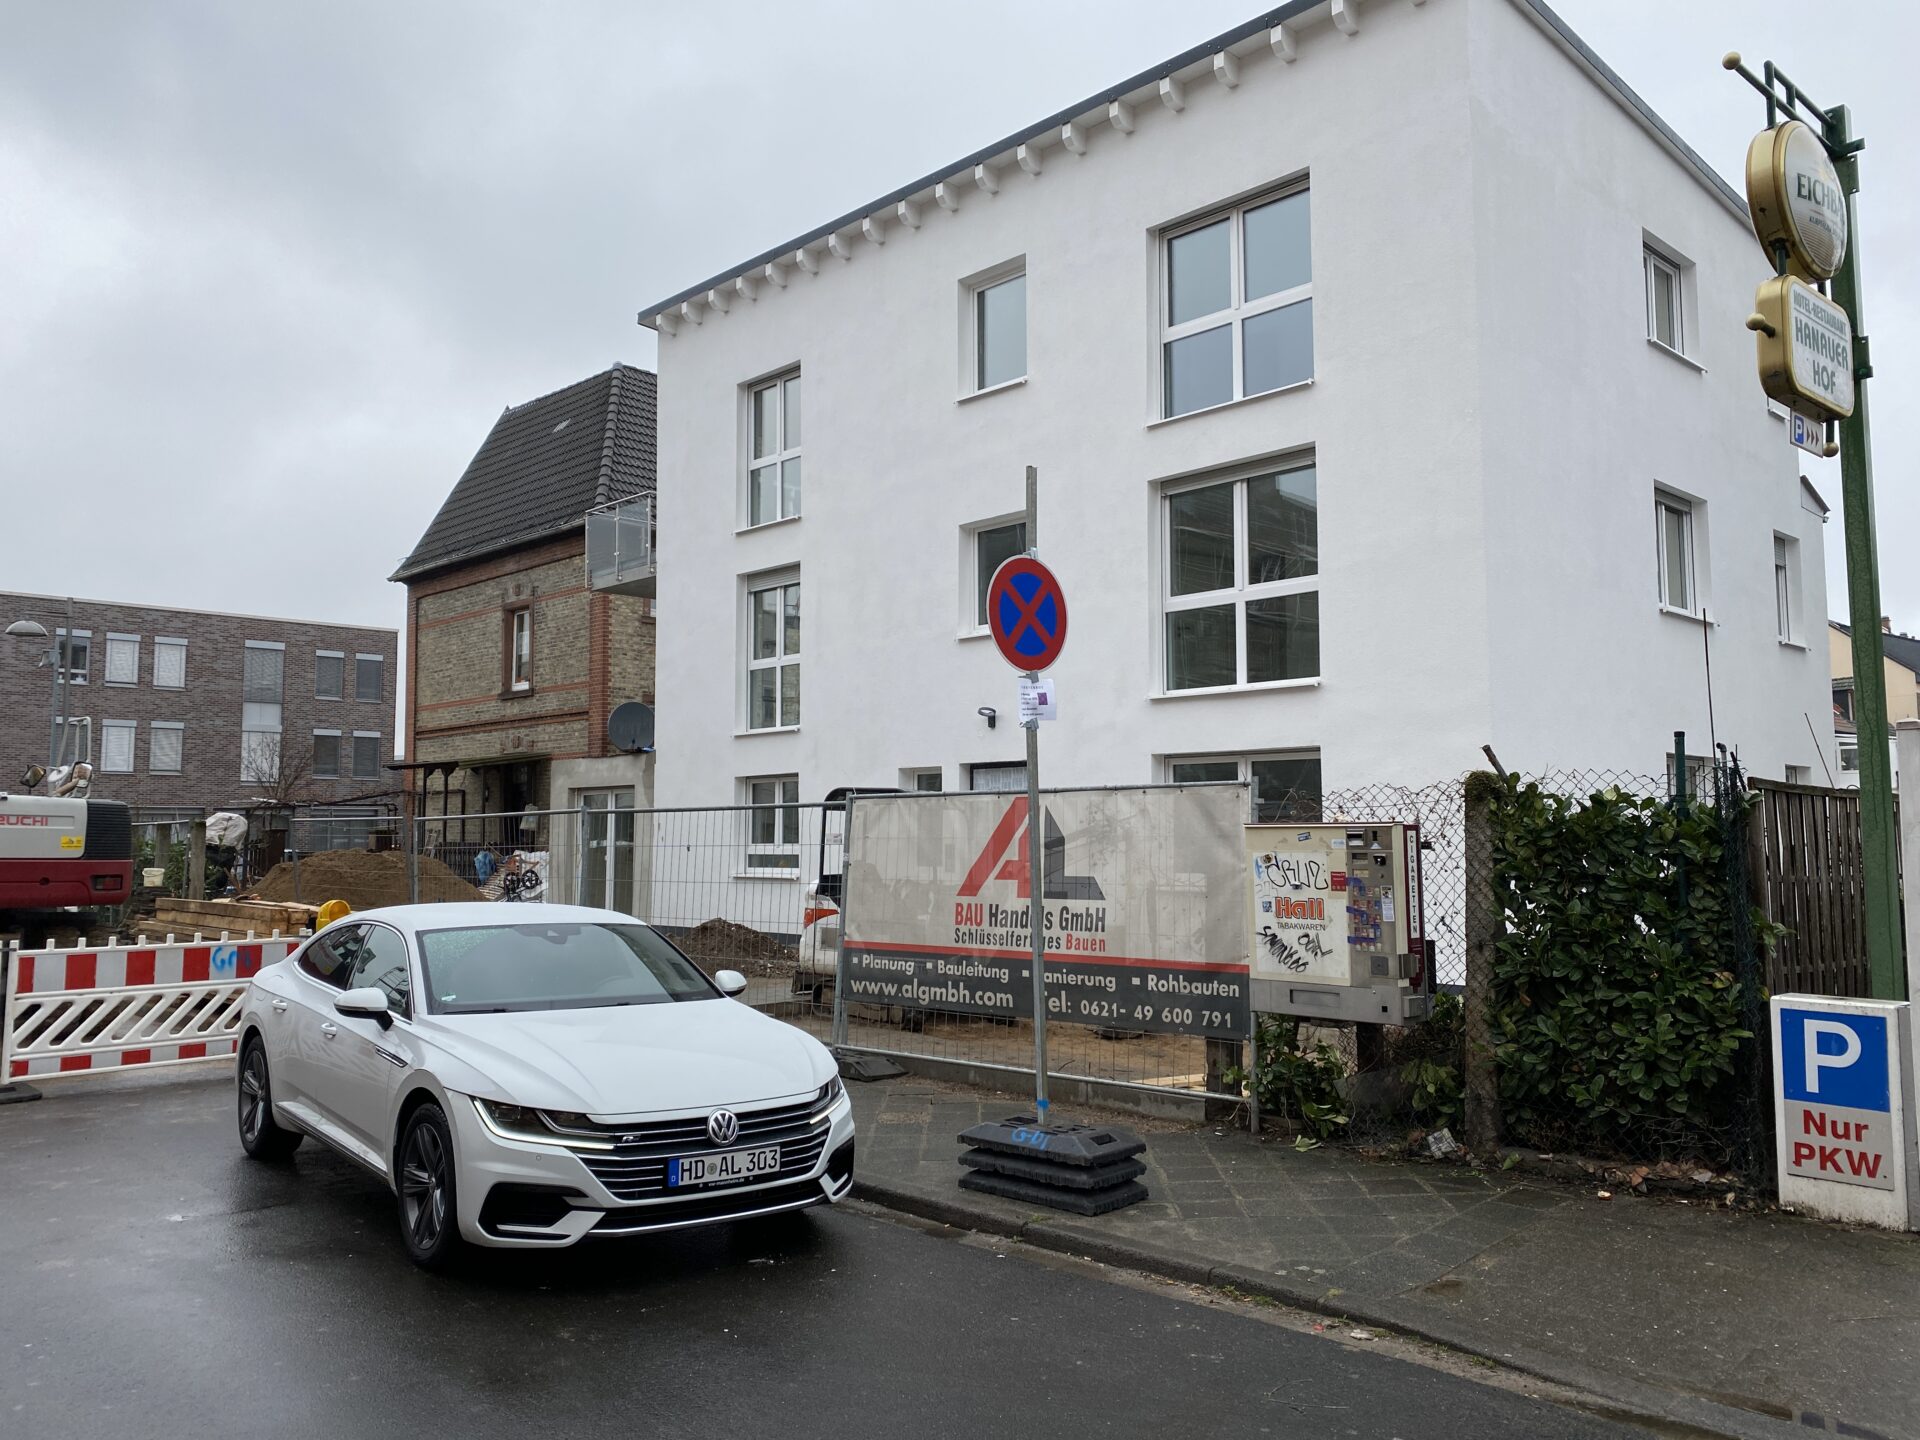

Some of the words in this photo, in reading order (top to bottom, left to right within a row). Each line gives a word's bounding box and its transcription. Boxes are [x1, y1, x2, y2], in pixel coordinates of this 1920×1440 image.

[1793, 290, 1847, 337] HOTEL-RESTAURANT
[1795, 316, 1849, 371] HANAUER
[1813, 359, 1836, 394] HOF
[1409, 835, 1418, 933] CIGARETTEN
[954, 902, 983, 927] BAU
[988, 903, 1053, 931] Handls
[1059, 905, 1106, 933] GmbH
[1275, 896, 1324, 920] Hall
[954, 928, 1061, 950] Schlüsselfertes
[1065, 933, 1106, 953] Bauen
[1276, 922, 1326, 931] TABAKWAREN
[862, 954, 915, 975] Planung
[937, 959, 1009, 984] Bauleitung
[1043, 968, 1116, 992] anierung
[1147, 974, 1240, 998] Rohbauten
[850, 978, 1014, 1008] www.algmbh.com
[1044, 990, 1072, 1014] el:
[1080, 1000, 1126, 1018] 0621-
[1134, 1005, 1153, 1020] 49
[1161, 1008, 1193, 1025] 600
[1202, 1010, 1231, 1028] 791
[1804, 1018, 1862, 1094] P
[1803, 1109, 1869, 1142] Nur
[681, 1159, 706, 1182] HD
[719, 1155, 742, 1177] AL
[746, 1149, 778, 1173] 303
[1793, 1141, 1882, 1179] PKW
